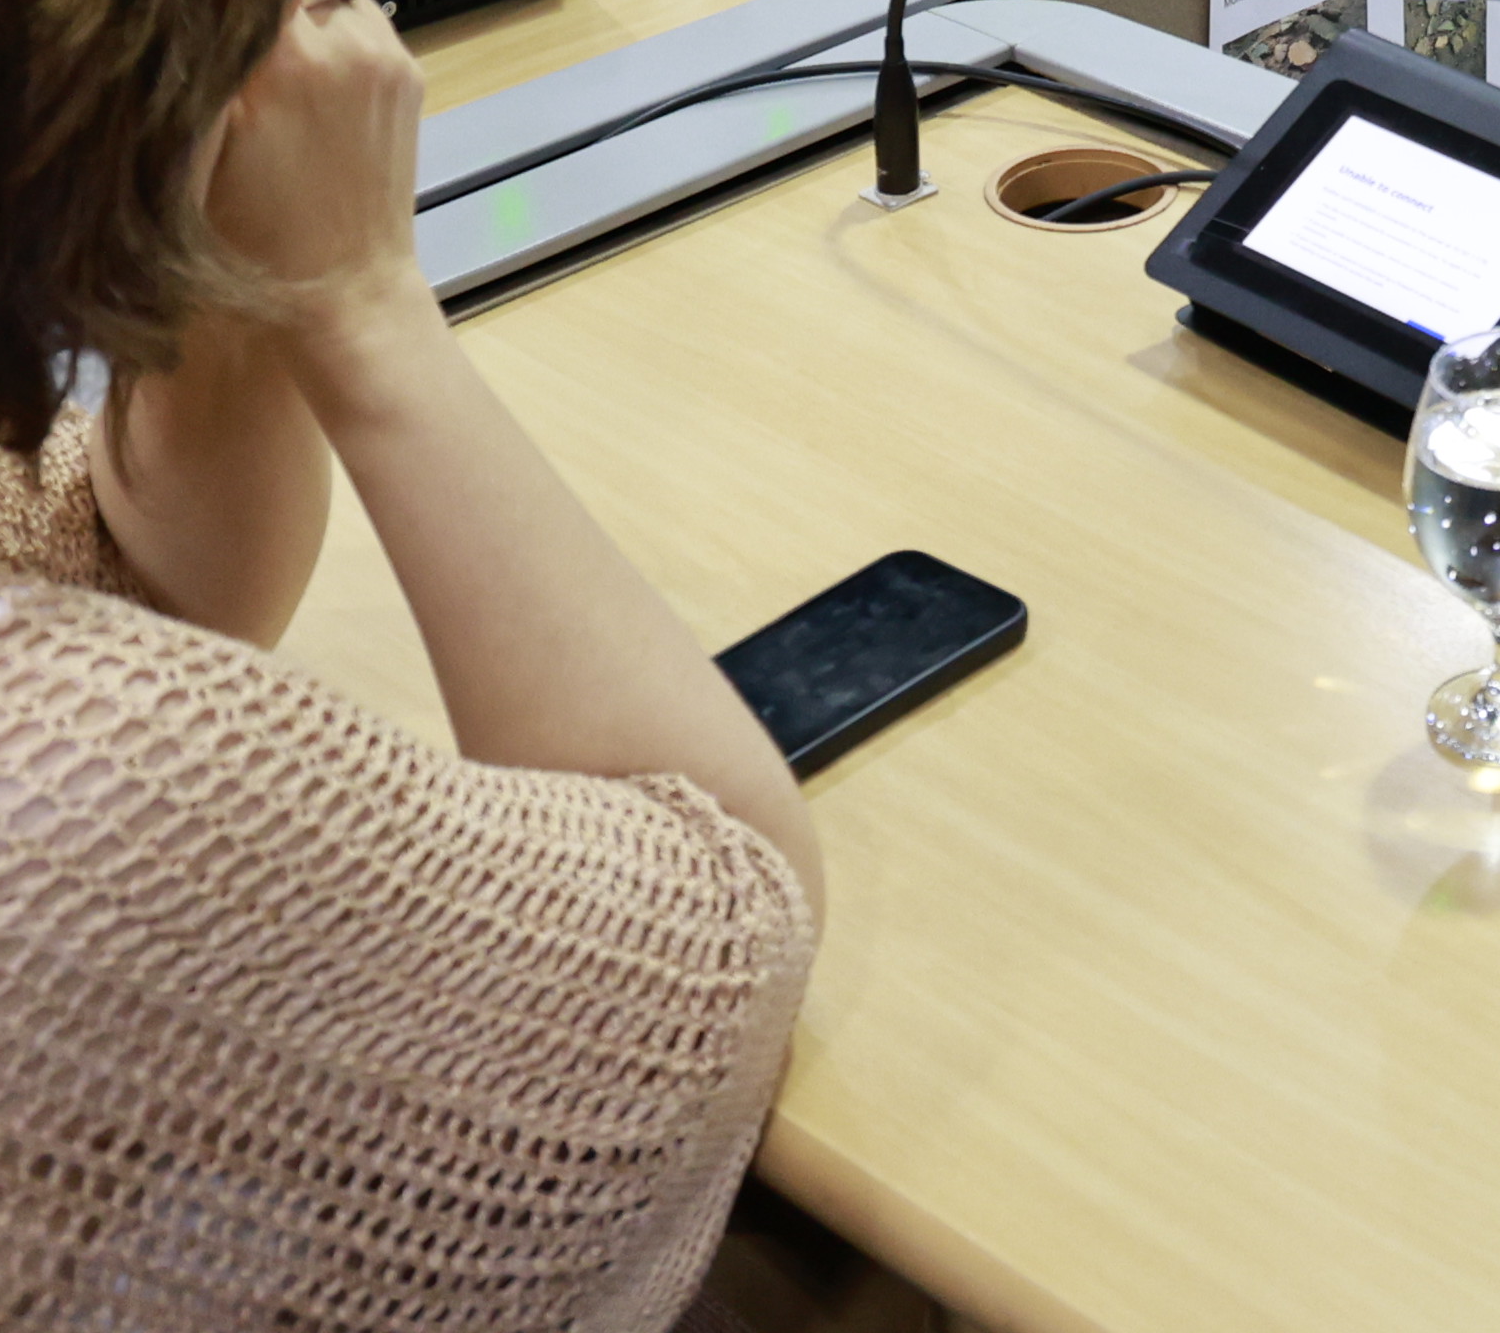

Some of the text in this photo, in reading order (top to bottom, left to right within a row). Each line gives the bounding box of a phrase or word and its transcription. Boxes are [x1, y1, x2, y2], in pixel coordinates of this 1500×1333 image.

[1339, 163, 1435, 215] Unable to connect
